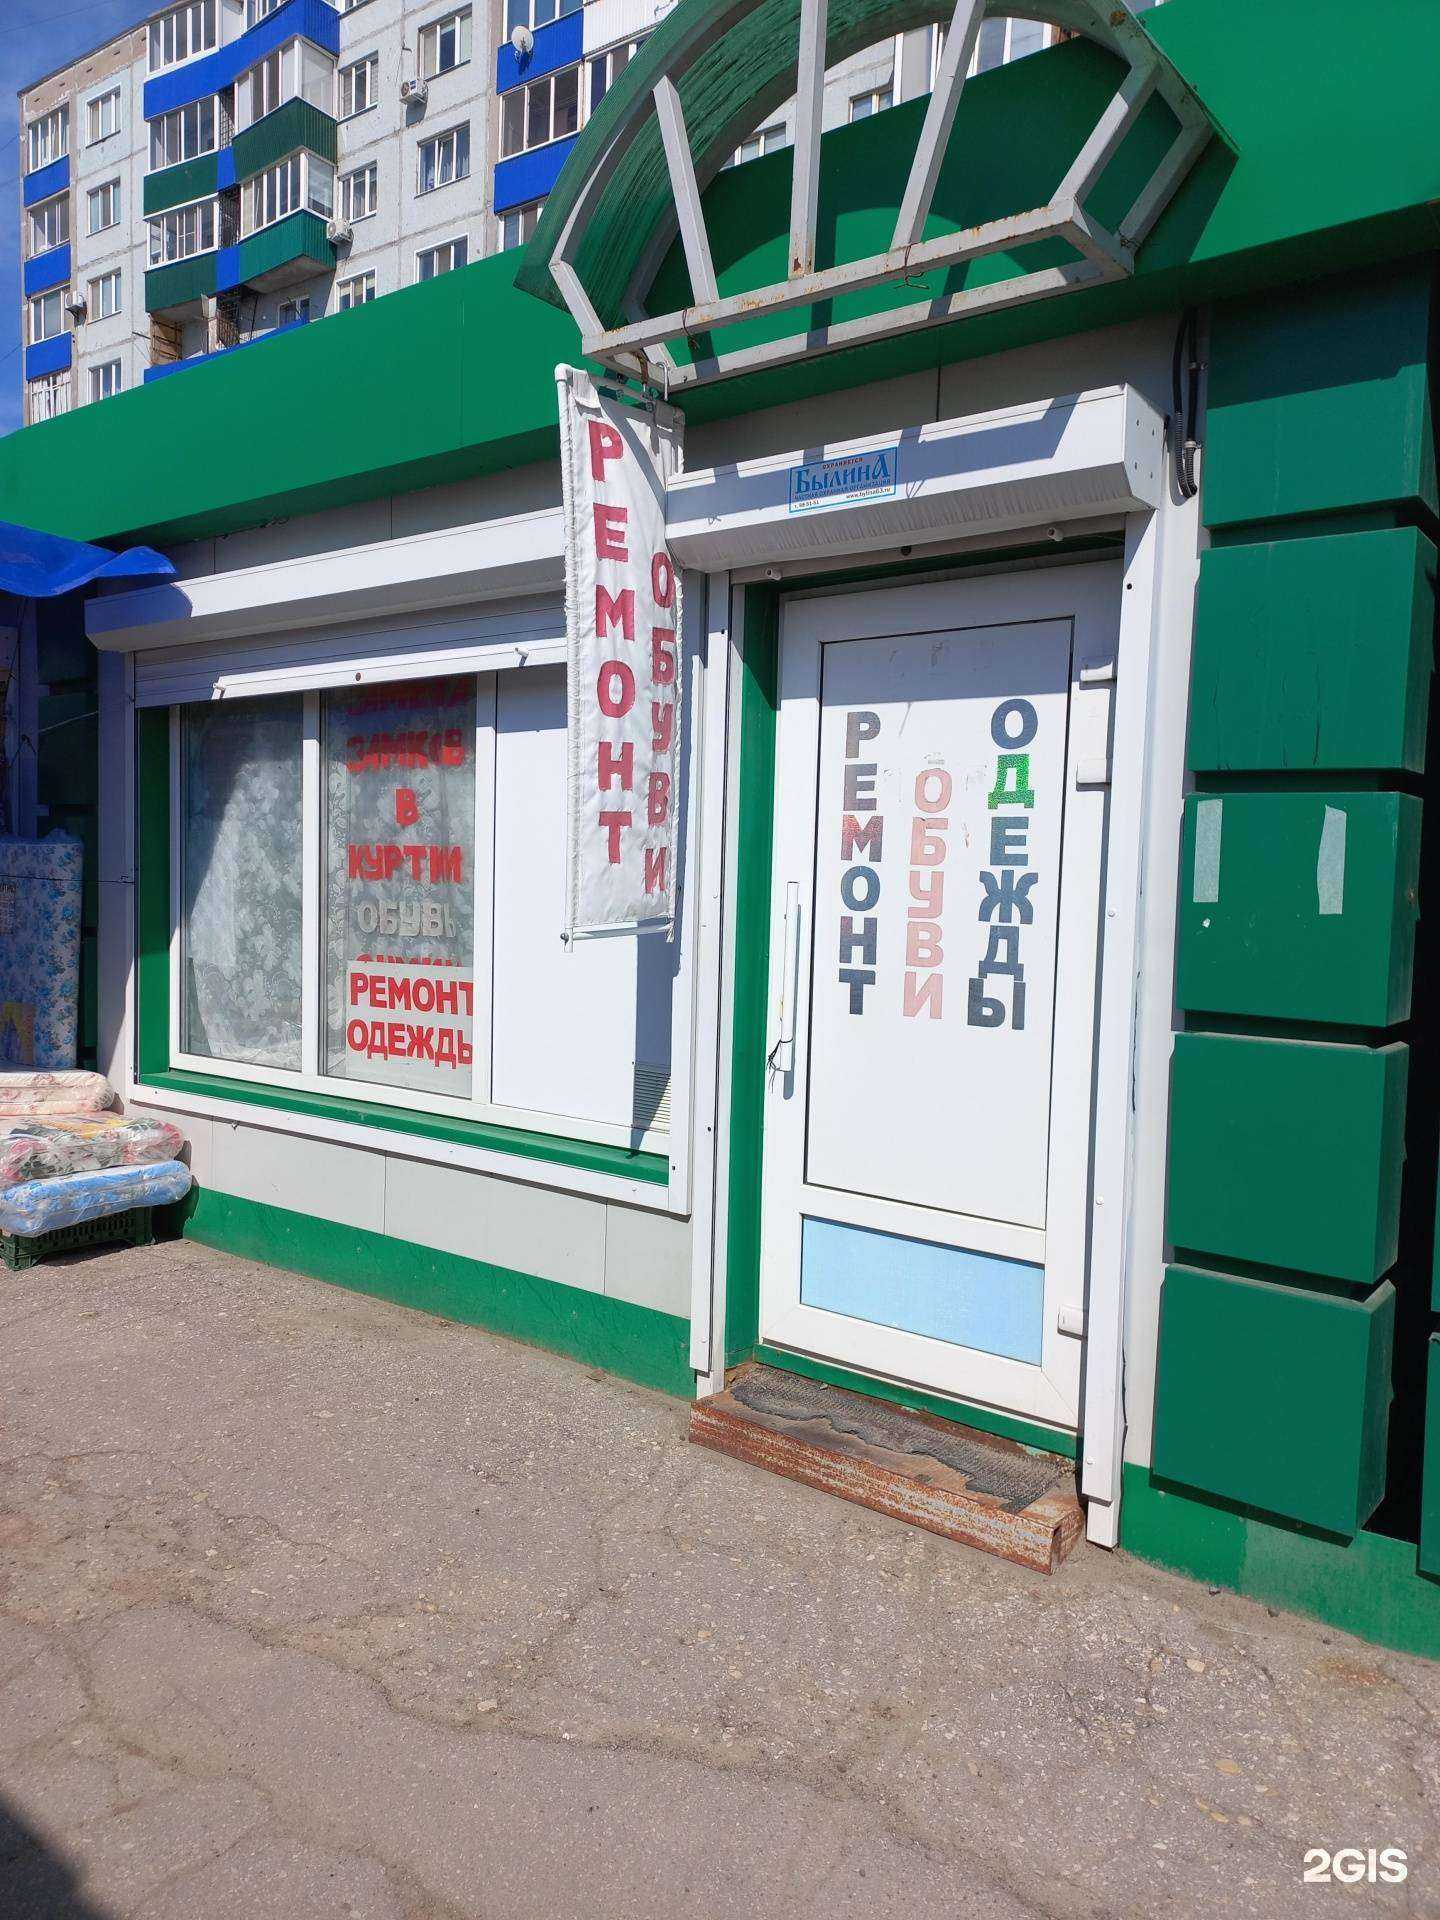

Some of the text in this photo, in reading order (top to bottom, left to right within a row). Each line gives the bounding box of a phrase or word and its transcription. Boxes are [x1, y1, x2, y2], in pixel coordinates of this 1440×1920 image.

[588, 420, 636, 864] РЕМОНТ
[645, 551, 675, 894] ОБУВИ
[395, 788, 420, 826] В
[838, 711, 883, 1015] РЕМОНТ
[903, 768, 952, 1019] ОБУВИ
[967, 698, 1038, 1031] ОДЕЖДЫ
[350, 972, 474, 1017] РЕМОНТ
